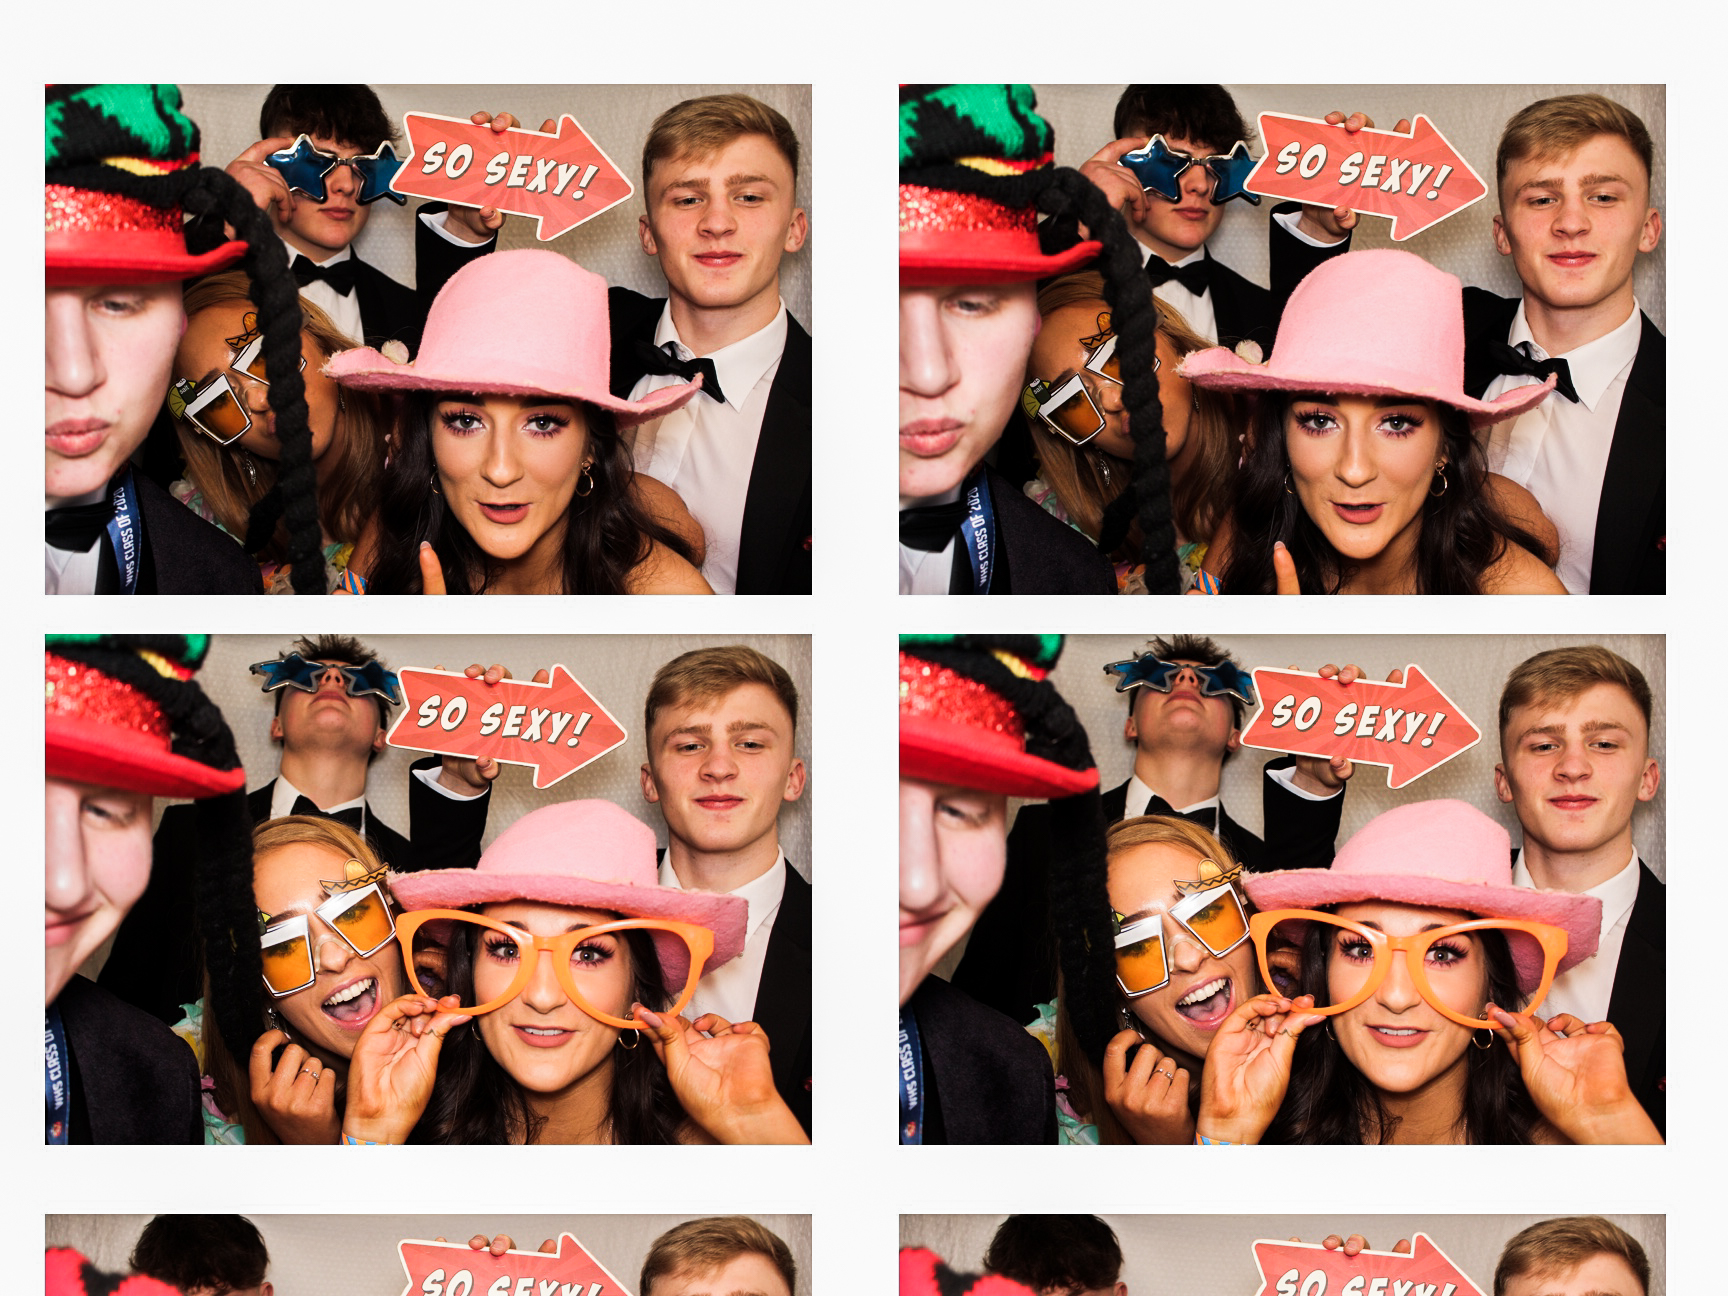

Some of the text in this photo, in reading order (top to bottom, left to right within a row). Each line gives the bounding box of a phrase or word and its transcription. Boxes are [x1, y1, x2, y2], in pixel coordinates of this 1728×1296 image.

[421, 141, 600, 201] SO SEXY!
[1275, 141, 1454, 201] SO SEXY!
[115, 514, 132, 529] OF
[969, 514, 986, 529] OF
[120, 527, 135, 561] CLASS
[974, 527, 989, 561] CLASS
[125, 560, 135, 587] WHS
[979, 560, 989, 587] WHS
[417, 694, 593, 748] SO SEXY!
[1271, 694, 1447, 748] SO SEXY!
[45, 1043, 62, 1081] CLASS
[899, 1043, 916, 1081] CLASS
[52, 1080, 64, 1111] WHS
[906, 1080, 918, 1111] WHS
